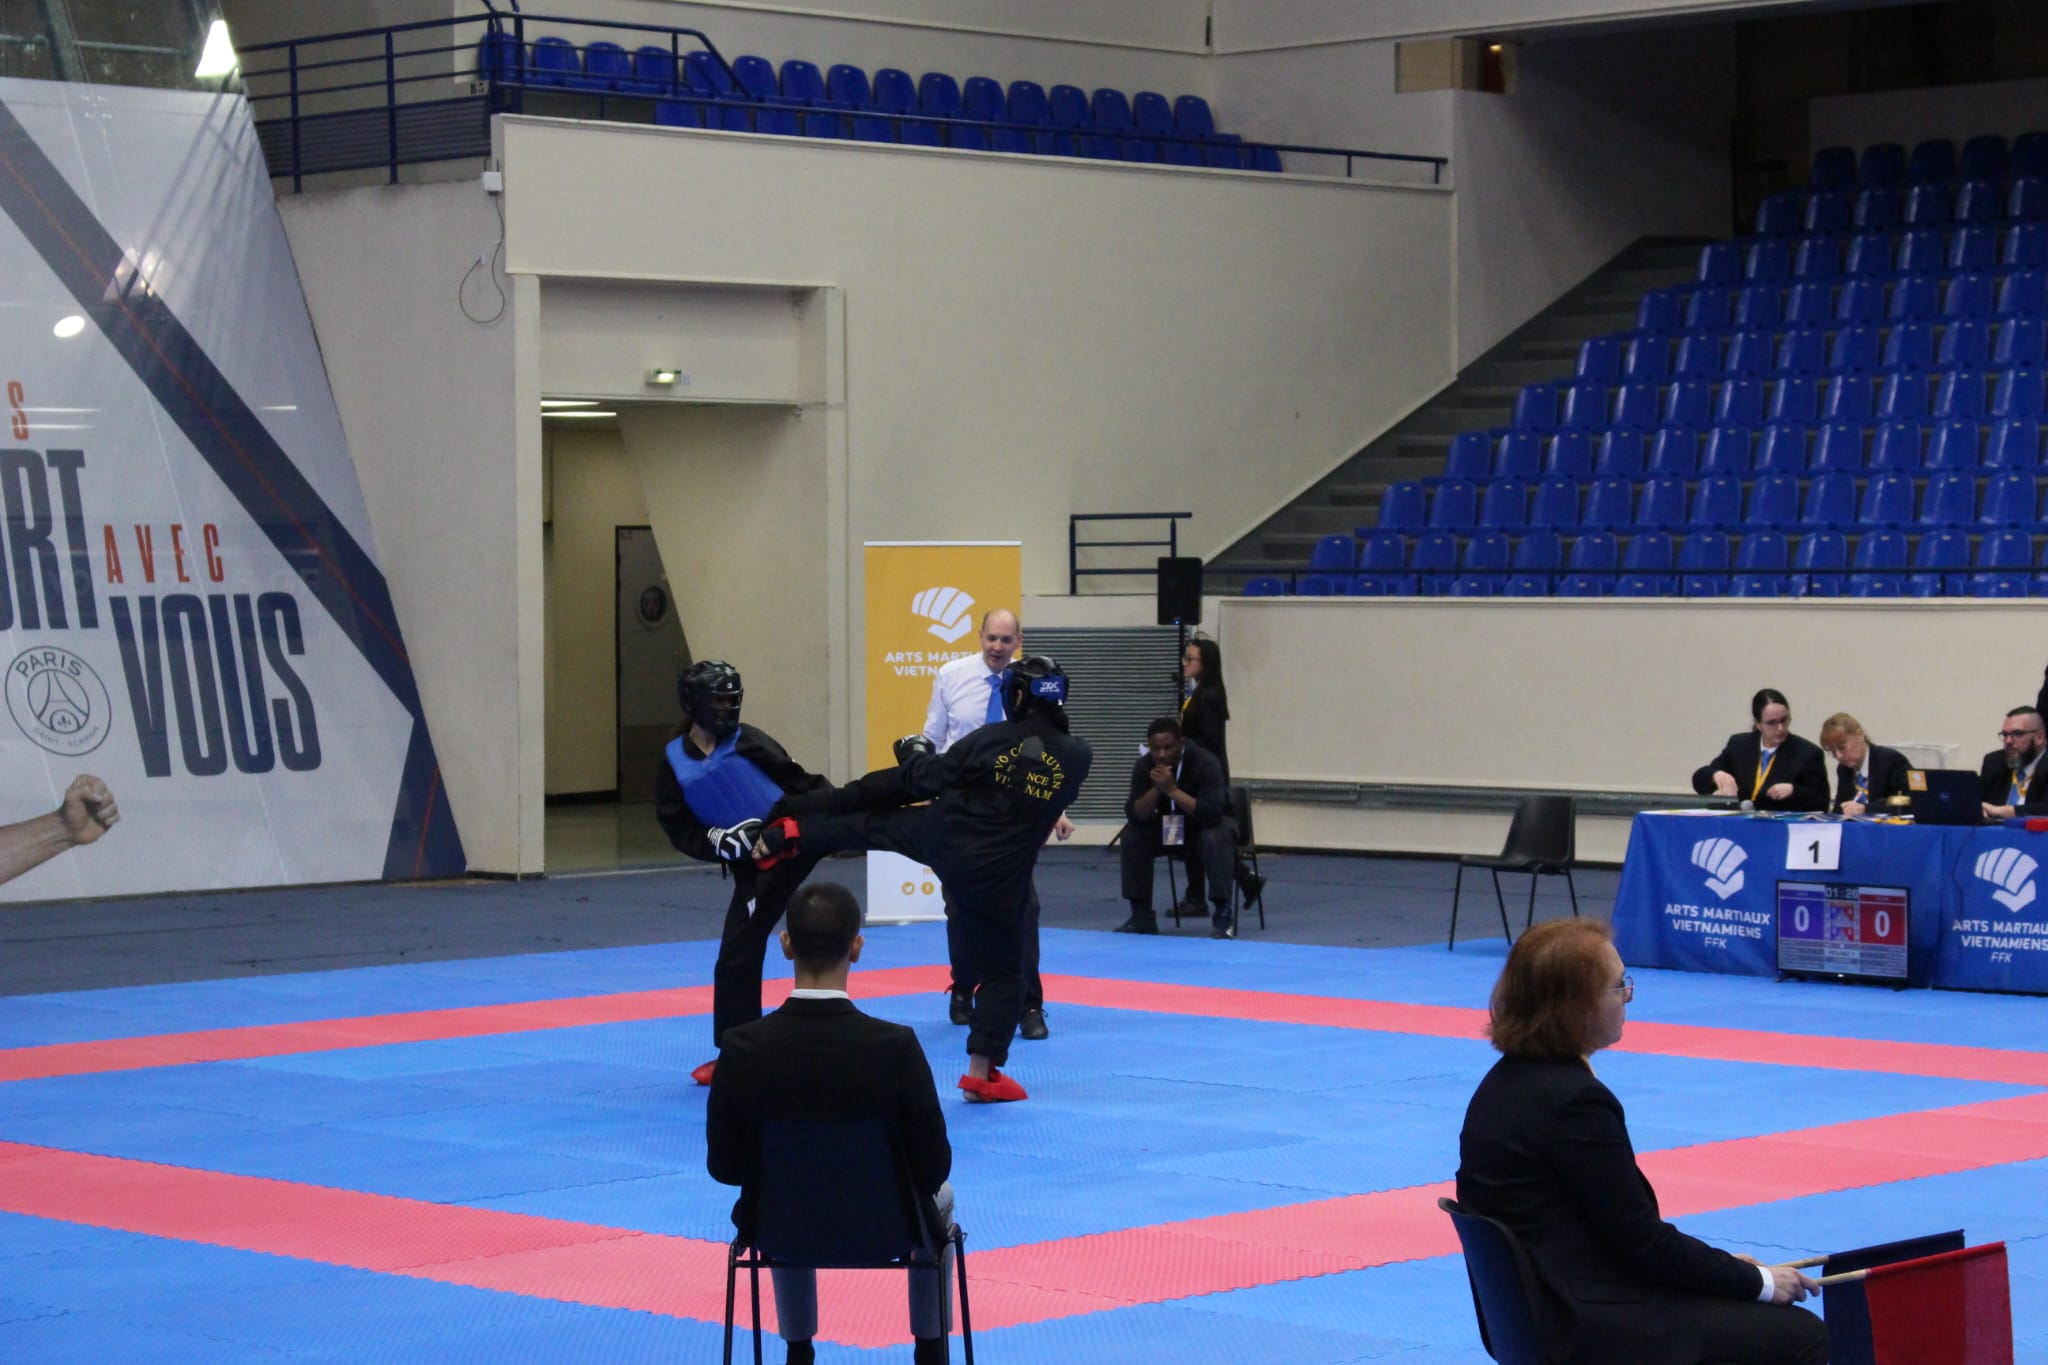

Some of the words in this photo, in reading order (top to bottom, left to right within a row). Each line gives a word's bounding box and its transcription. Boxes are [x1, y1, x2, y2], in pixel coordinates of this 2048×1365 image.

[0, 449, 99, 631] RT
[103, 523, 225, 584] AVEC
[15, 651, 82, 678] PARIS
[884, 651, 922, 662] ARTS
[108, 592, 322, 778] VOUS
[1024, 784, 1053, 800] NAM
[1808, 840, 1820, 864] 1
[1665, 903, 1699, 918] ARTS
[1702, 907, 1771, 925] MARTIAUX
[1794, 905, 1810, 933] 0
[1874, 910, 1891, 939] 0
[1672, 918, 1762, 939] VIETNAMIENS
[1952, 919, 1990, 933] ARTS
[1704, 936, 1728, 949] FFK
[1961, 935, 2048, 951] VIETNAMIENS
[1990, 951, 2013, 963] FFK
